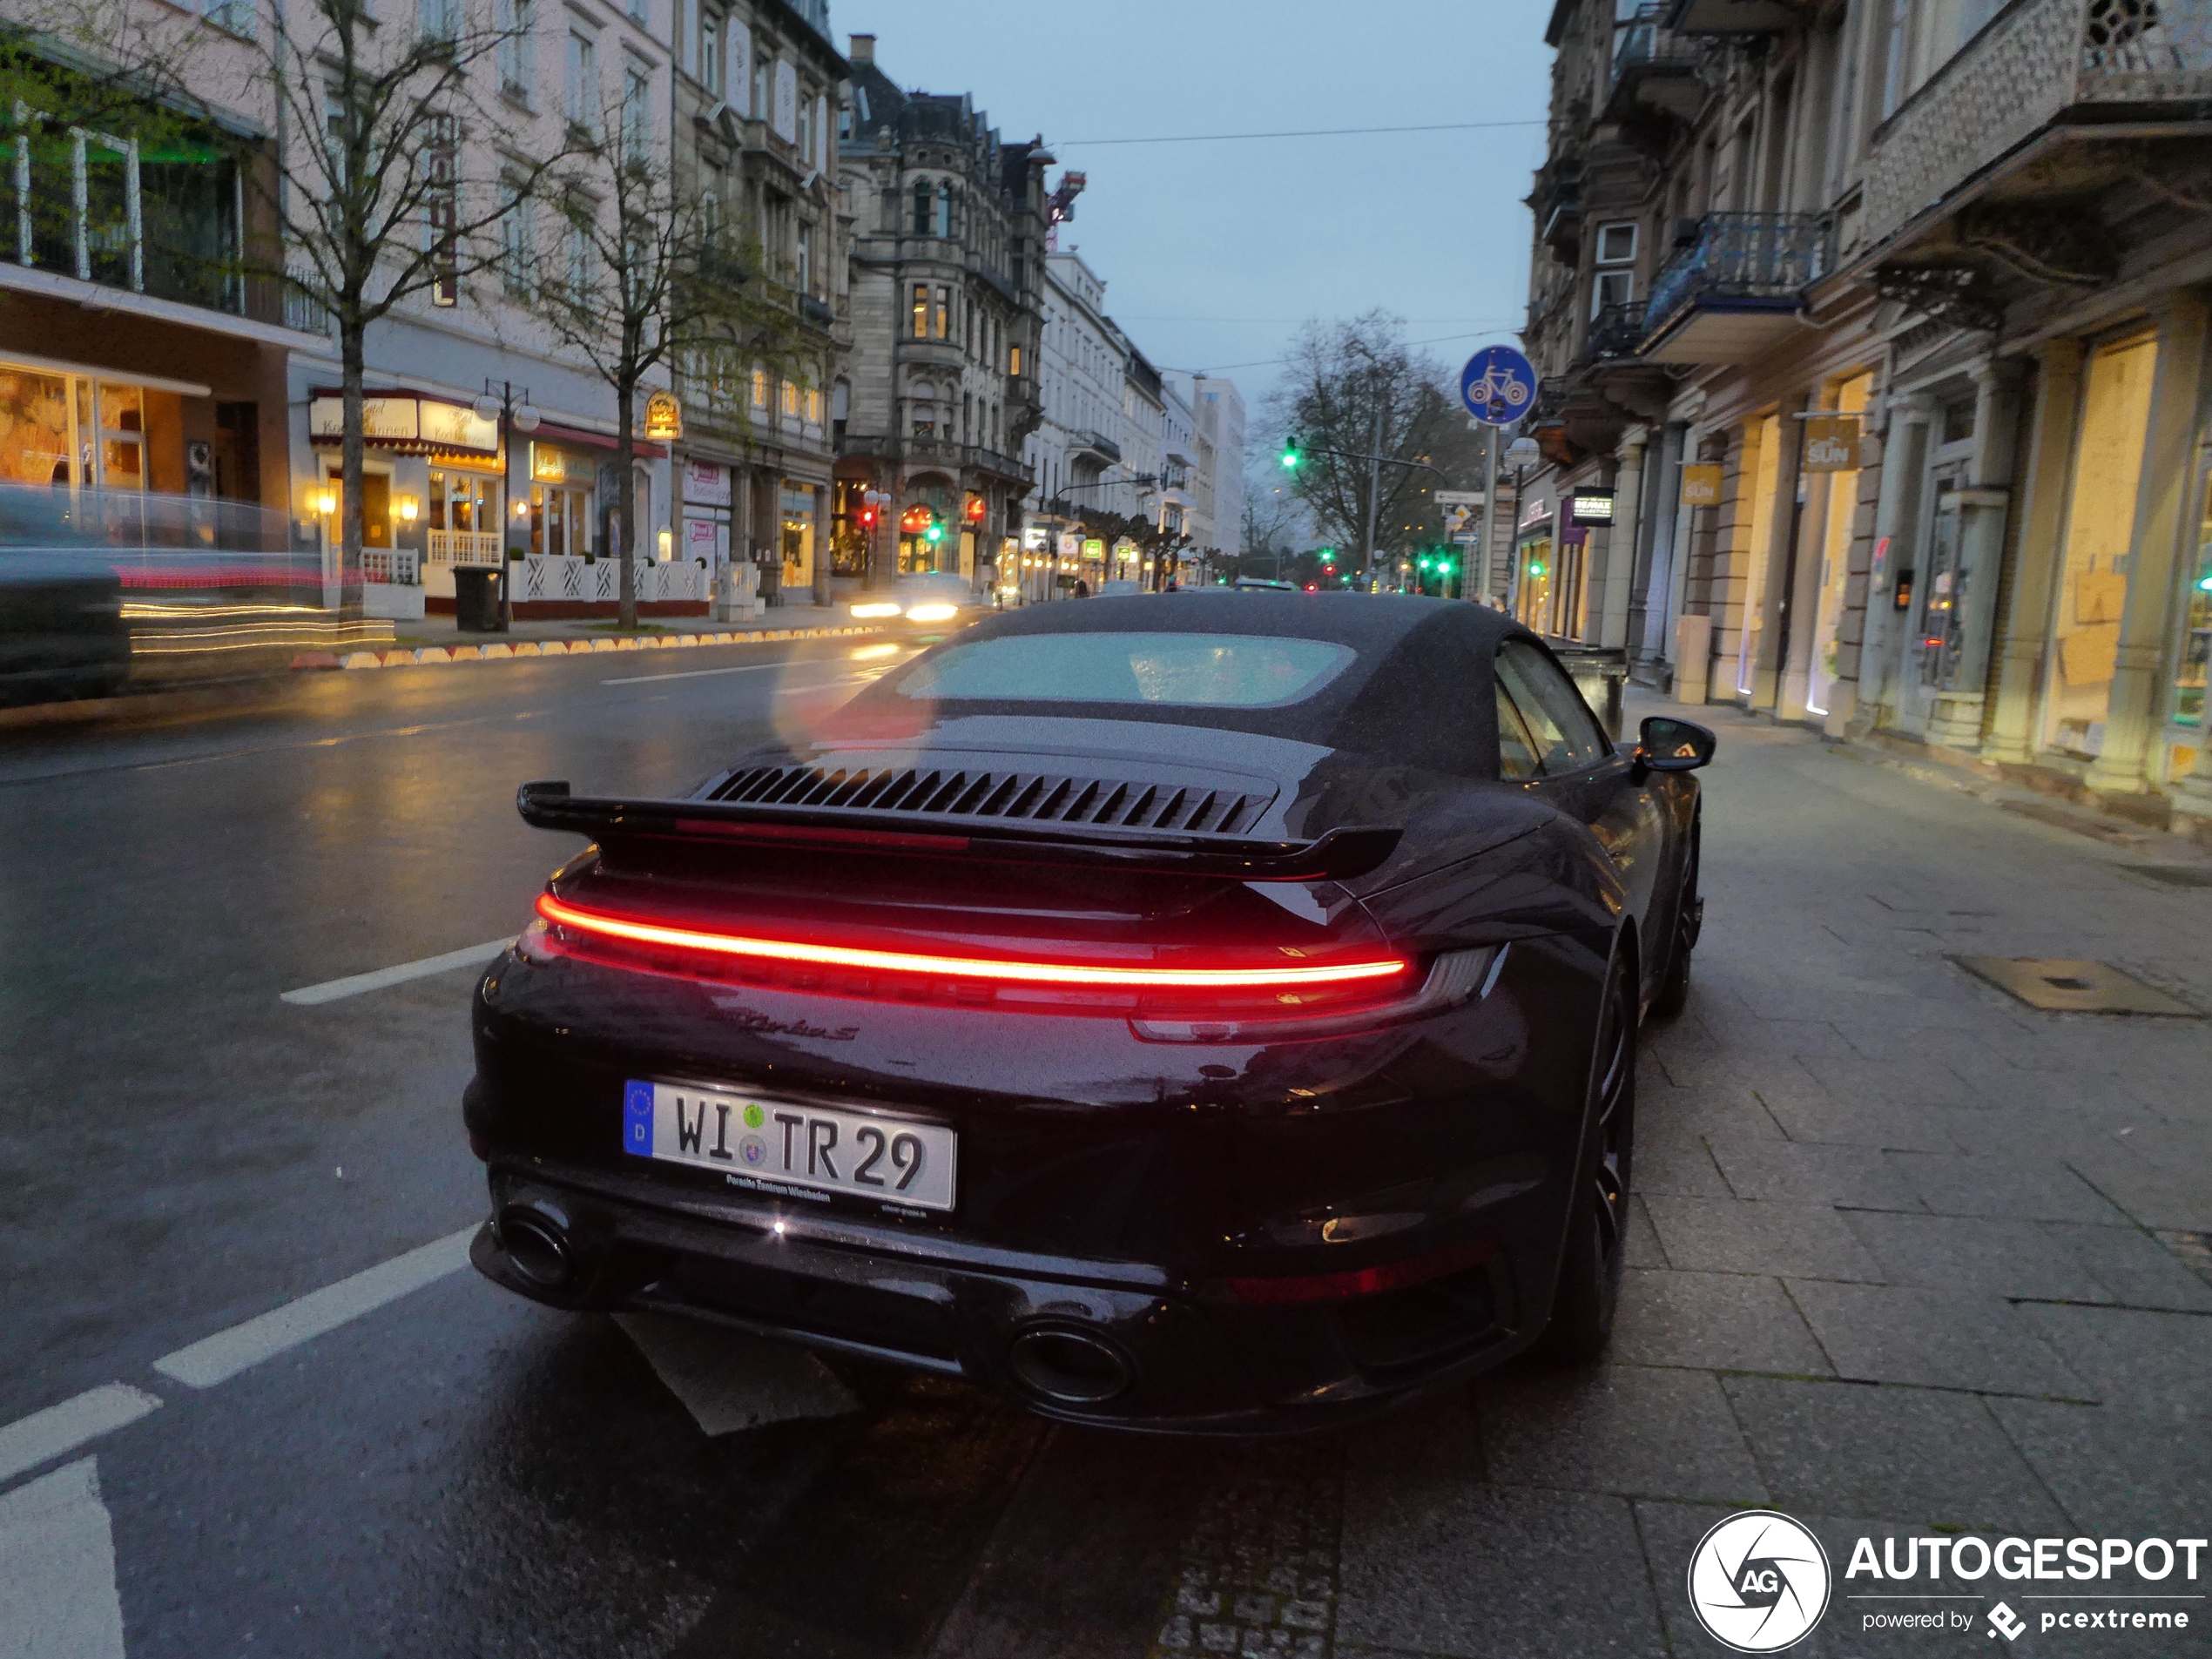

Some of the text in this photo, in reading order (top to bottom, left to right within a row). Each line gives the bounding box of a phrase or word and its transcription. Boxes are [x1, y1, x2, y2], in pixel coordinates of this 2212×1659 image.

[1575, 501, 1611, 509] RE/MAX
[635, 1123, 645, 1142] D
[675, 1096, 924, 1191] WI TR 29
[756, 1179, 788, 1195] Zentrum
[788, 1185, 831, 1203] Wiesbaden
